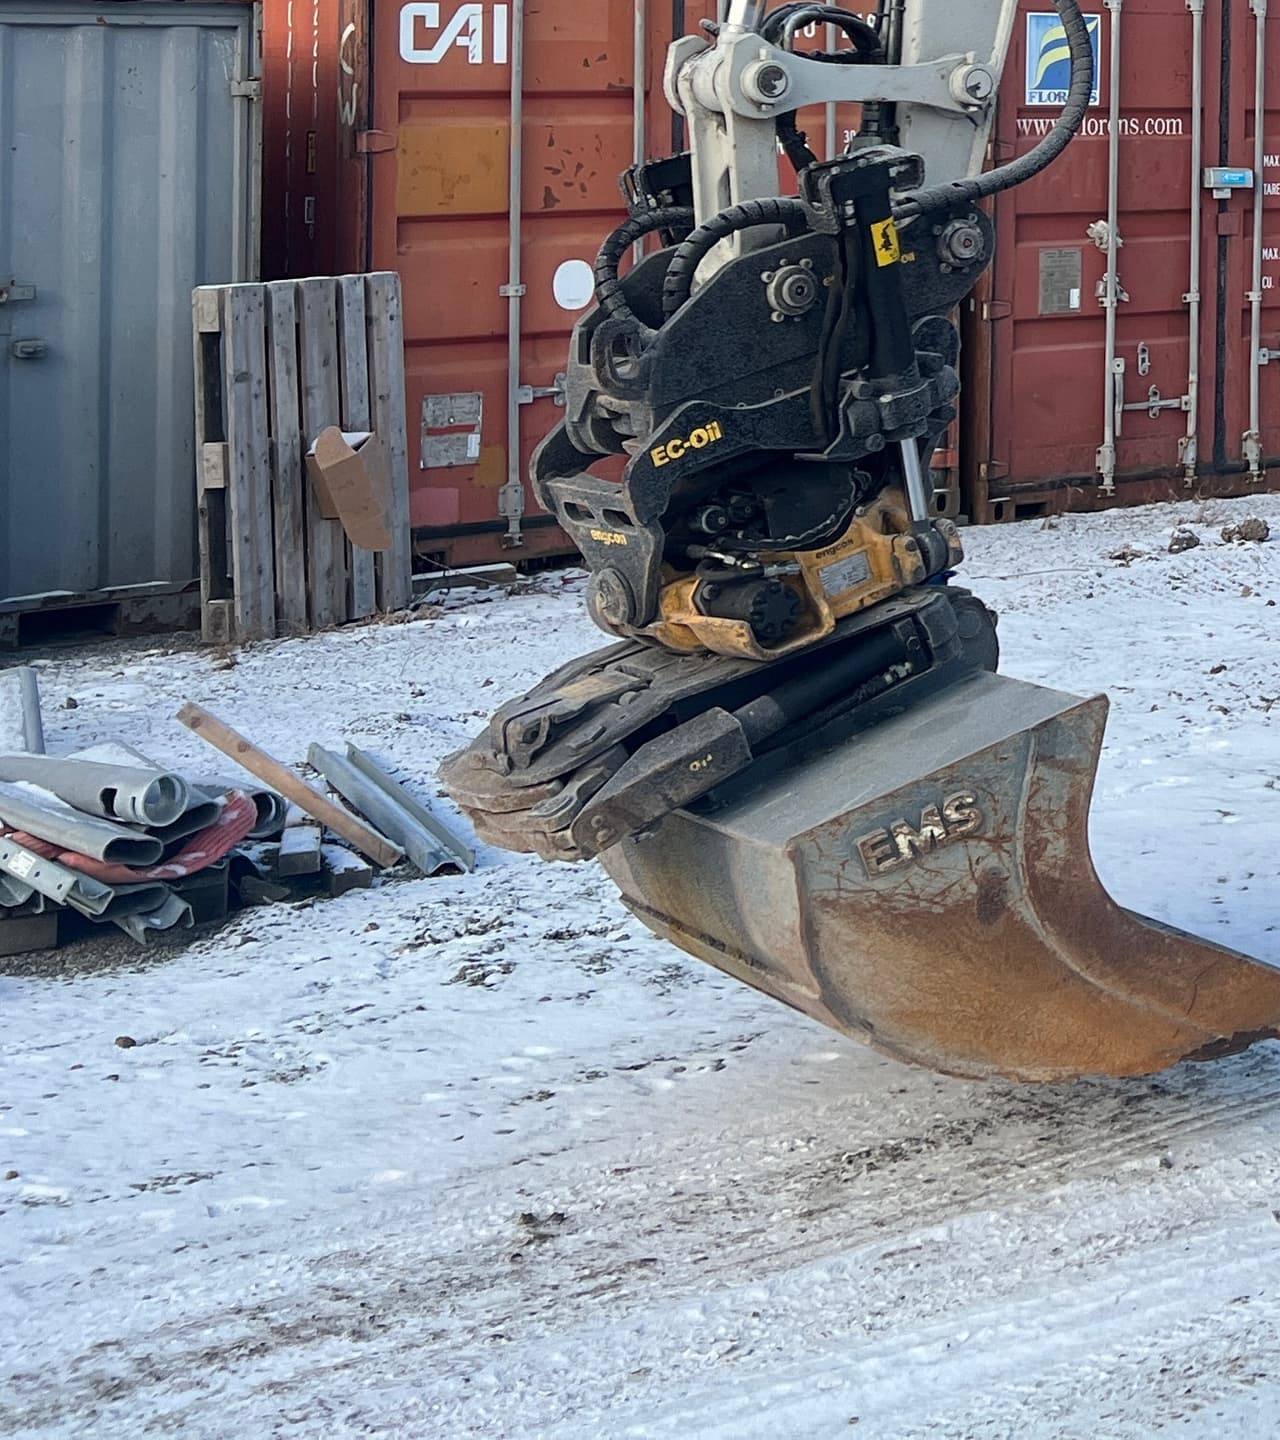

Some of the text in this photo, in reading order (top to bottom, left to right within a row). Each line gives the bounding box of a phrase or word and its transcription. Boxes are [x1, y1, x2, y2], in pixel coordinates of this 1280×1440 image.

[399, 2, 508, 64] CAI
[1028, 90, 1098, 104] FLORS
[1263, 182, 1280, 195] TARE
[650, 421, 722, 468] EC-Oil
[815, 538, 854, 559] engcon
[856, 790, 981, 880] EMS
